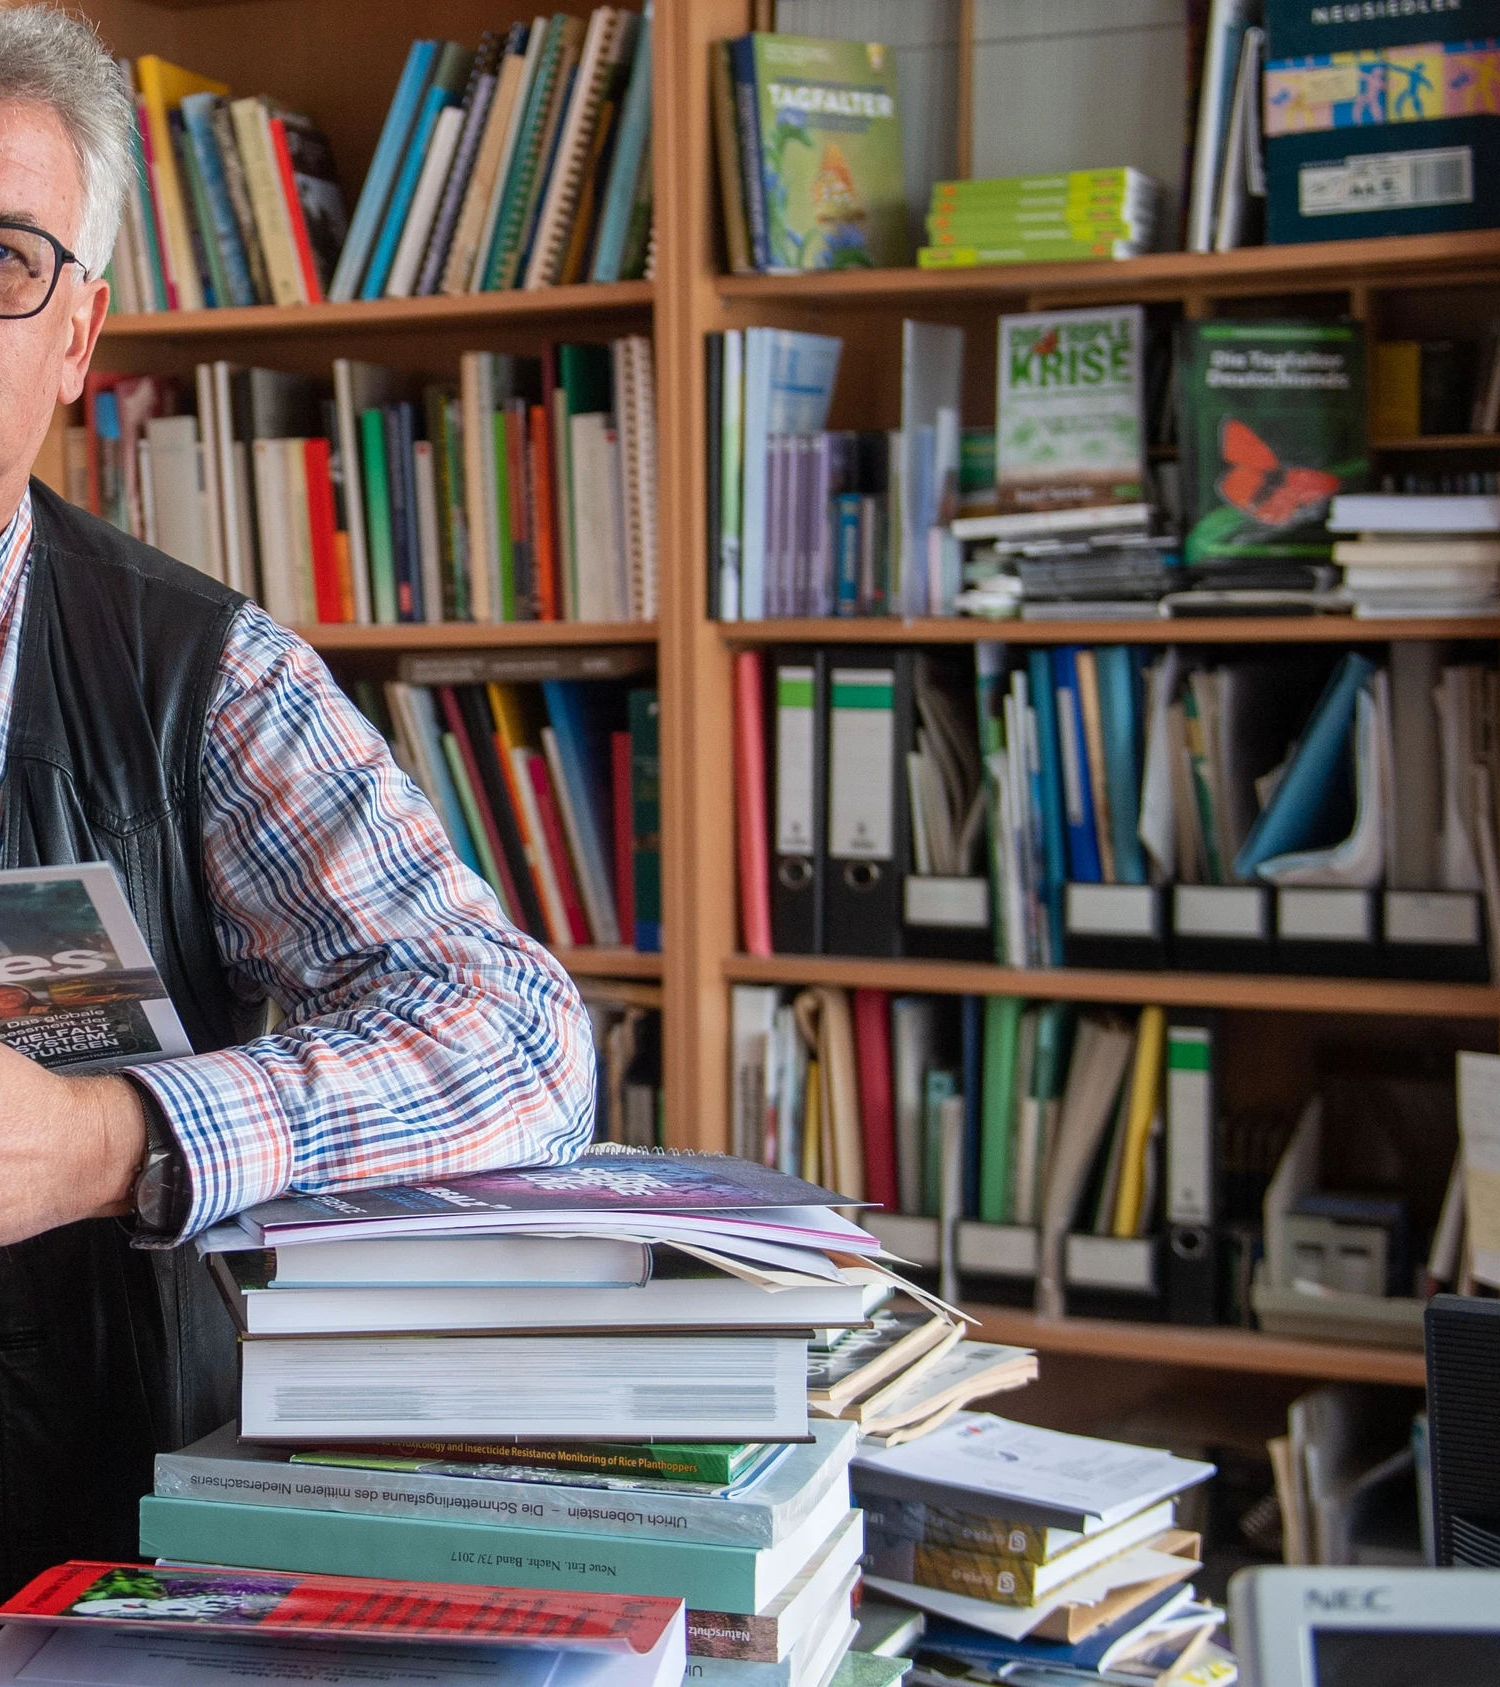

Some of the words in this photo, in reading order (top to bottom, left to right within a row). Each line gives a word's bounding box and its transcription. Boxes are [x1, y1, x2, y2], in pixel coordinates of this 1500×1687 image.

[1310, 0, 1462, 25] NEUSIEDLER
[767, 83, 894, 118] TAGFALTER
[1009, 341, 1133, 388] KRISE
[6, 1018, 40, 1029] Das
[44, 1009, 105, 1023] globale
[80, 1016, 108, 1025] der
[7, 1023, 111, 1046] VIELFALT
[15, 1032, 116, 1054] SYSTEM-
[24, 1038, 120, 1060] TUNGEN
[313, 1194, 368, 1214] ERENCE
[446, 1442, 464, 1452] and
[464, 1443, 511, 1456] Insecticide
[511, 1446, 557, 1460] Resistance
[558, 1451, 606, 1467] Monitoring
[607, 1455, 618, 1466] of
[618, 1456, 637, 1468] Rice
[638, 1457, 698, 1473] Planthoppers
[190, 1474, 292, 1495] Niedersachsens
[295, 1483, 350, 1498] mittleren
[354, 1488, 378, 1501] des
[382, 1491, 518, 1515] Schmetterlingsfauna
[521, 1503, 544, 1516] Die
[567, 1507, 643, 1525] Lobenstein
[647, 1515, 688, 1529] Ulrich
[450, 1551, 475, 1564] 2017
[496, 1554, 523, 1568] Band
[526, 1557, 561, 1571] Nachr.
[564, 1561, 587, 1574] Ent.
[588, 1564, 617, 1577] Neue
[1305, 1587, 1393, 1613] NEC
[687, 1626, 751, 1642] Naturschutz
[685, 1665, 703, 1678] Ulr
